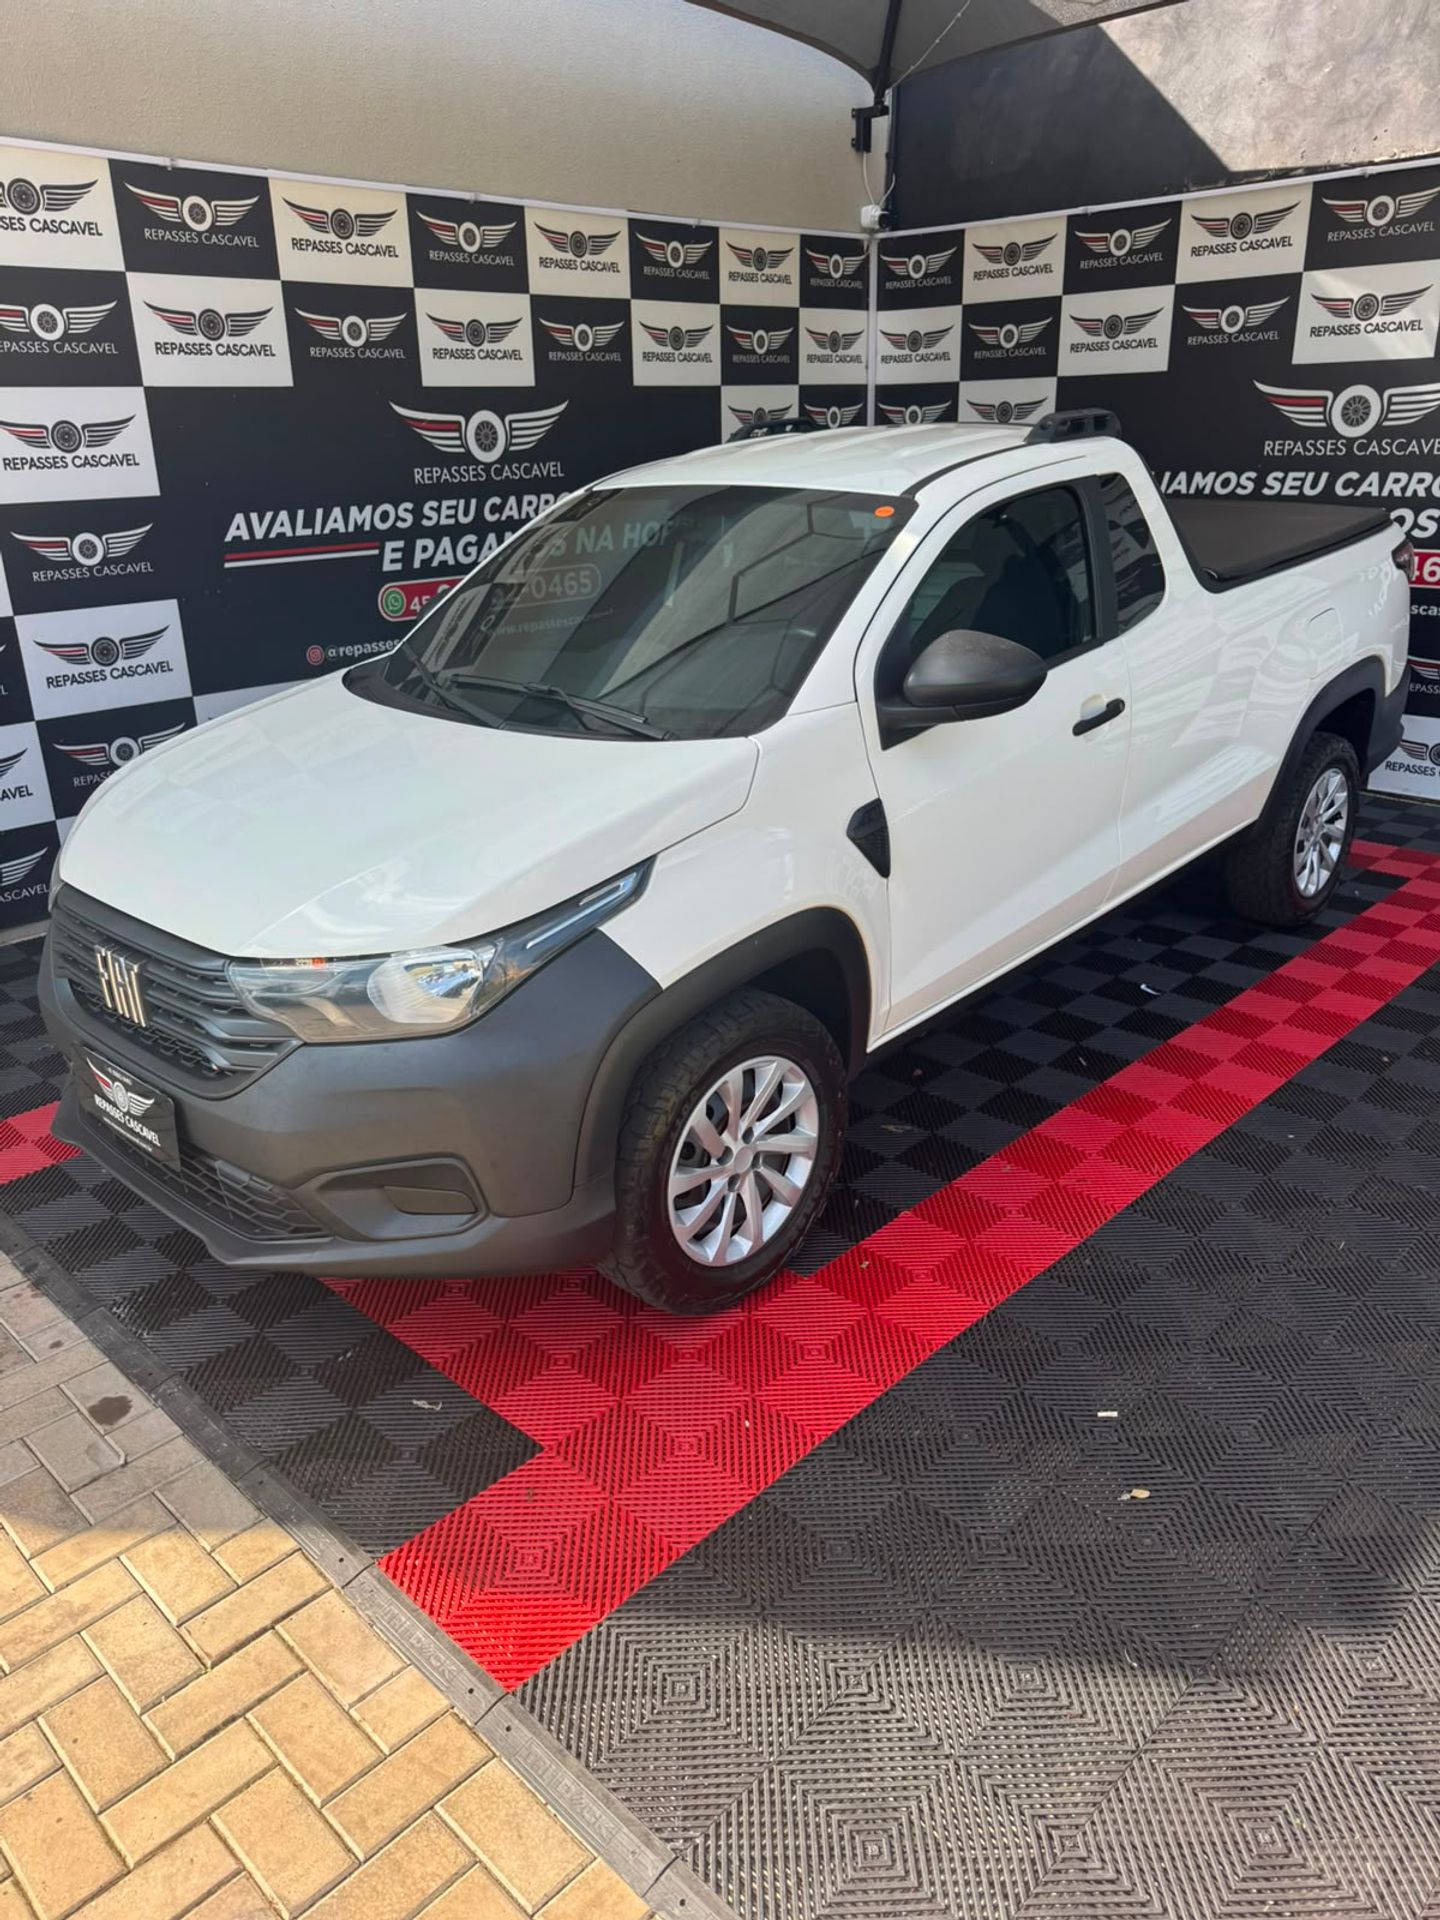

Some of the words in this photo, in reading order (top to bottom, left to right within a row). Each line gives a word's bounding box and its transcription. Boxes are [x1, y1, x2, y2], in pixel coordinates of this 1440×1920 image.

[30, 218, 103, 236] CASCAVEL
[1327, 228, 1375, 242] REPASSES
[1378, 221, 1436, 236] CASCAVEL
[144, 228, 199, 244] REPASSES
[202, 233, 260, 248] CASCAVEL
[1191, 242, 1238, 257] REPASSES
[1239, 236, 1293, 251] CASCAVEL
[291, 238, 343, 254] REPASSES
[345, 242, 399, 258] CASCAVEL
[429, 250, 470, 263] REPASSES
[472, 253, 515, 267] CASCAVEL
[539, 257, 578, 270] REPASSES
[580, 260, 621, 274] CASCAVEL
[1079, 256, 1119, 270] REPASSES
[1120, 252, 1164, 266] CASCAVEL
[643, 266, 674, 278] REPASSES
[676, 268, 710, 280] CASCAVEL
[728, 271, 759, 283] REPASSES
[760, 274, 793, 285] CASCAVEL
[973, 269, 1009, 281] REPASSES
[1010, 264, 1054, 276] CASCAVEL
[885, 278, 916, 290] REPASSES
[917, 276, 953, 288] CASCAVEL
[1310, 324, 1361, 338] REPASSES
[1364, 320, 1424, 335] CASCAVEL
[1070, 342, 1112, 353] REPASSES
[1112, 338, 1158, 350] CASCAVEL
[1187, 334, 1230, 347] REPASSES
[1231, 330, 1281, 343] CASCAVEL
[53, 341, 119, 354] CASCAVEL
[155, 342, 213, 356] REPASSES
[215, 343, 276, 357] CASCAVEL
[310, 347, 356, 359] REPASSES
[358, 348, 407, 360] CASCAVEL
[432, 348, 476, 360] REPASSES
[478, 349, 523, 361] CASCAVEL
[974, 349, 1008, 360] REPASSES
[1009, 346, 1047, 358] CASCAVEL
[548, 351, 584, 362] REPASSES
[585, 352, 622, 362] CASCAVEL
[642, 352, 676, 363] REPASSES
[676, 352, 713, 364] CASCAVEL
[881, 353, 913, 364] REPASSES
[914, 352, 952, 363] CASCAVEL
[1263, 440, 1346, 456] REPASSES
[1353, 437, 1440, 456] CASCAVE
[3, 456, 69, 471] REPASSES
[71, 454, 140, 469] CASCAVEL
[414, 465, 486, 484] REPASSES
[490, 461, 564, 481] CASCAVEL
[1159, 471, 1258, 496] IAMOS
[1261, 471, 1329, 496] SEU
[224, 503, 414, 542] AVALIAMOS
[421, 497, 477, 526] SEU
[483, 491, 570, 522] CARR
[382, 540, 404, 571] E
[413, 530, 512, 570] PAGA
[33, 568, 90, 582] REPASSES
[94, 562, 154, 578] CASCAVEL
[46, 670, 107, 690] REPASSES
[110, 660, 174, 682] CASCAVEL
[1384, 760, 1436, 777] REPASSES
[0, 784, 34, 802] AVEL
[124, 1115, 162, 1148] CASCAVEL
